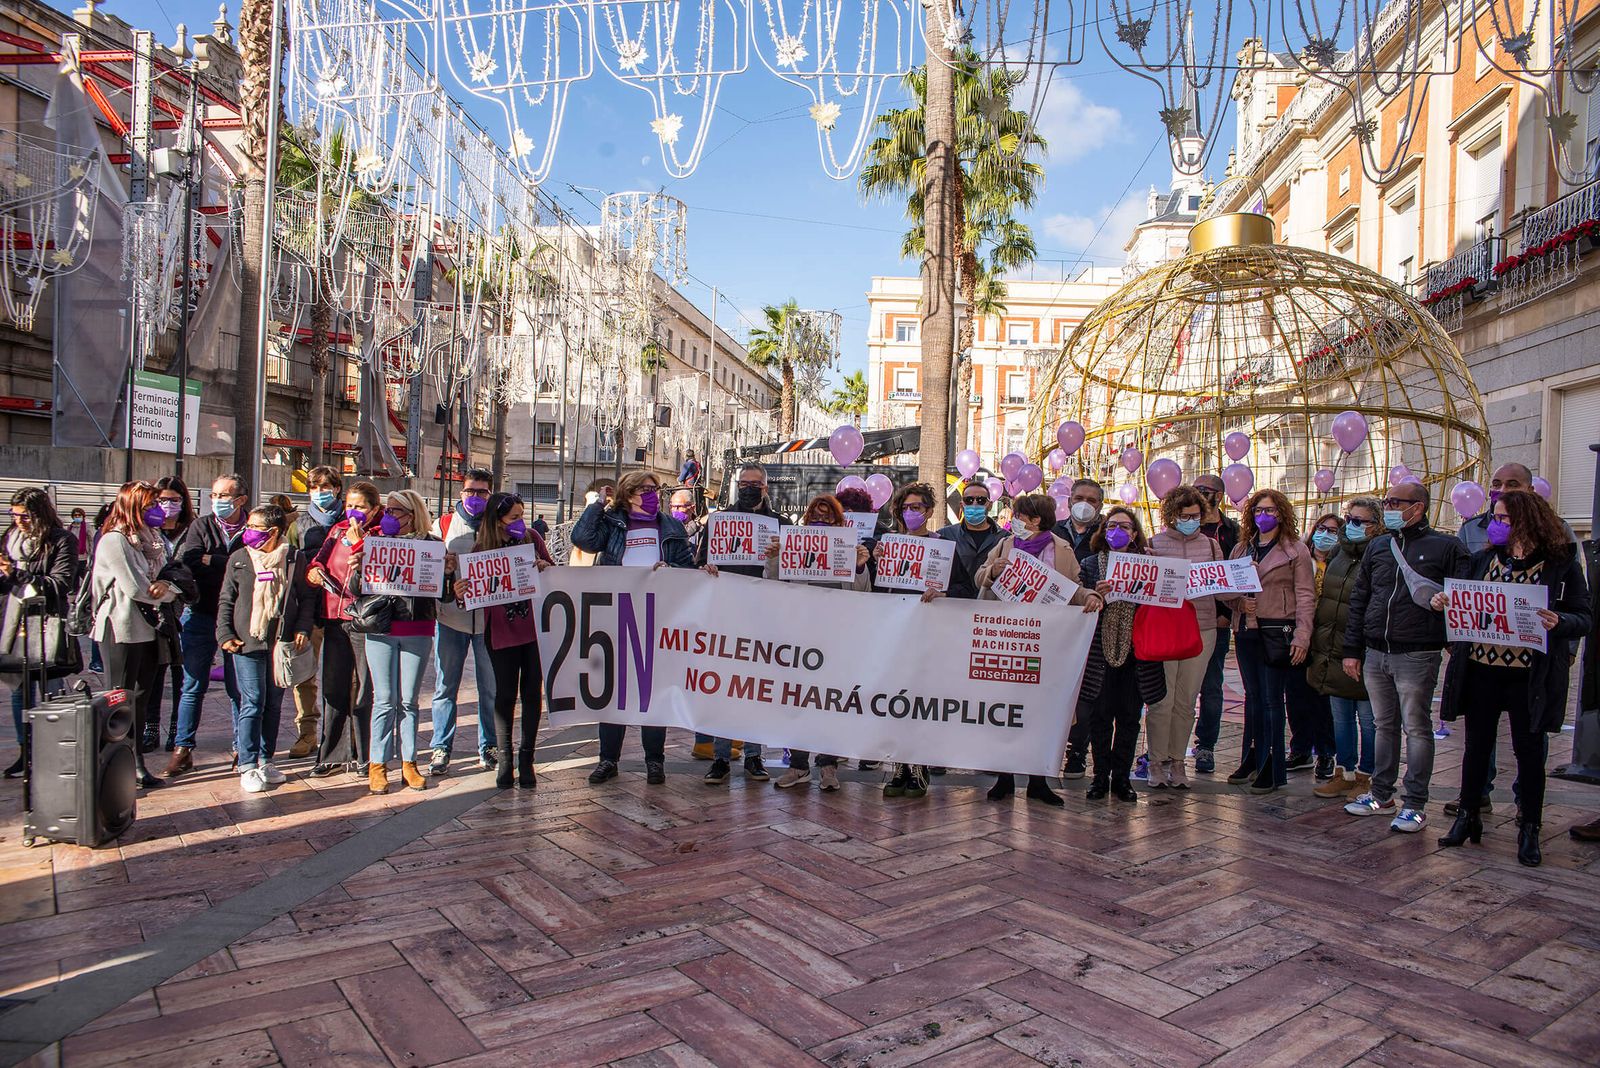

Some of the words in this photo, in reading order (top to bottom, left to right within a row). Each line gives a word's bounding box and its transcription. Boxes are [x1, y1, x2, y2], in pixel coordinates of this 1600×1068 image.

[133, 403, 190, 420] Rehabilitacn
[132, 416, 162, 428] Edificio
[714, 521, 753, 537] ACOSO
[710, 536, 756, 554] SEXUAL
[785, 535, 828, 552] ACOSO
[884, 542, 925, 561] ACOSO
[369, 547, 415, 566] ACOSO
[781, 552, 831, 570] SEXUAL
[1029, 558, 1043, 571] CONTRA
[364, 565, 416, 584] SEXUAL
[468, 557, 510, 580] ACOSO
[878, 559, 923, 580] SEXUAL
[1012, 558, 1048, 591] ACOSO
[1112, 562, 1158, 581] ACOSO
[1190, 565, 1226, 579] COSO
[466, 575, 515, 598] SEXUAL
[1186, 578, 1233, 588] EXUAL
[1468, 584, 1492, 592] CONTRA
[488, 592, 513, 601] TRABAJO
[1451, 590, 1507, 614] ACOSO
[974, 614, 1041, 627] Erradicación
[1448, 610, 1514, 634] SEXUAL
[973, 627, 983, 635] de
[986, 627, 997, 637] las
[1000, 628, 1040, 640] violencias
[1478, 631, 1510, 640] TRABAJO
[541, 591, 655, 713] 25N
[659, 627, 688, 652] MI
[693, 631, 824, 670] SILENCIO
[972, 639, 1040, 652] MACHISTAS
[972, 654, 1025, 670] CCOO
[972, 669, 1037, 681] enseñanza
[685, 667, 720, 694] NO
[727, 675, 774, 703] ME
[781, 682, 863, 714] HARÁ
[870, 689, 1024, 728] CÓMPLICE
